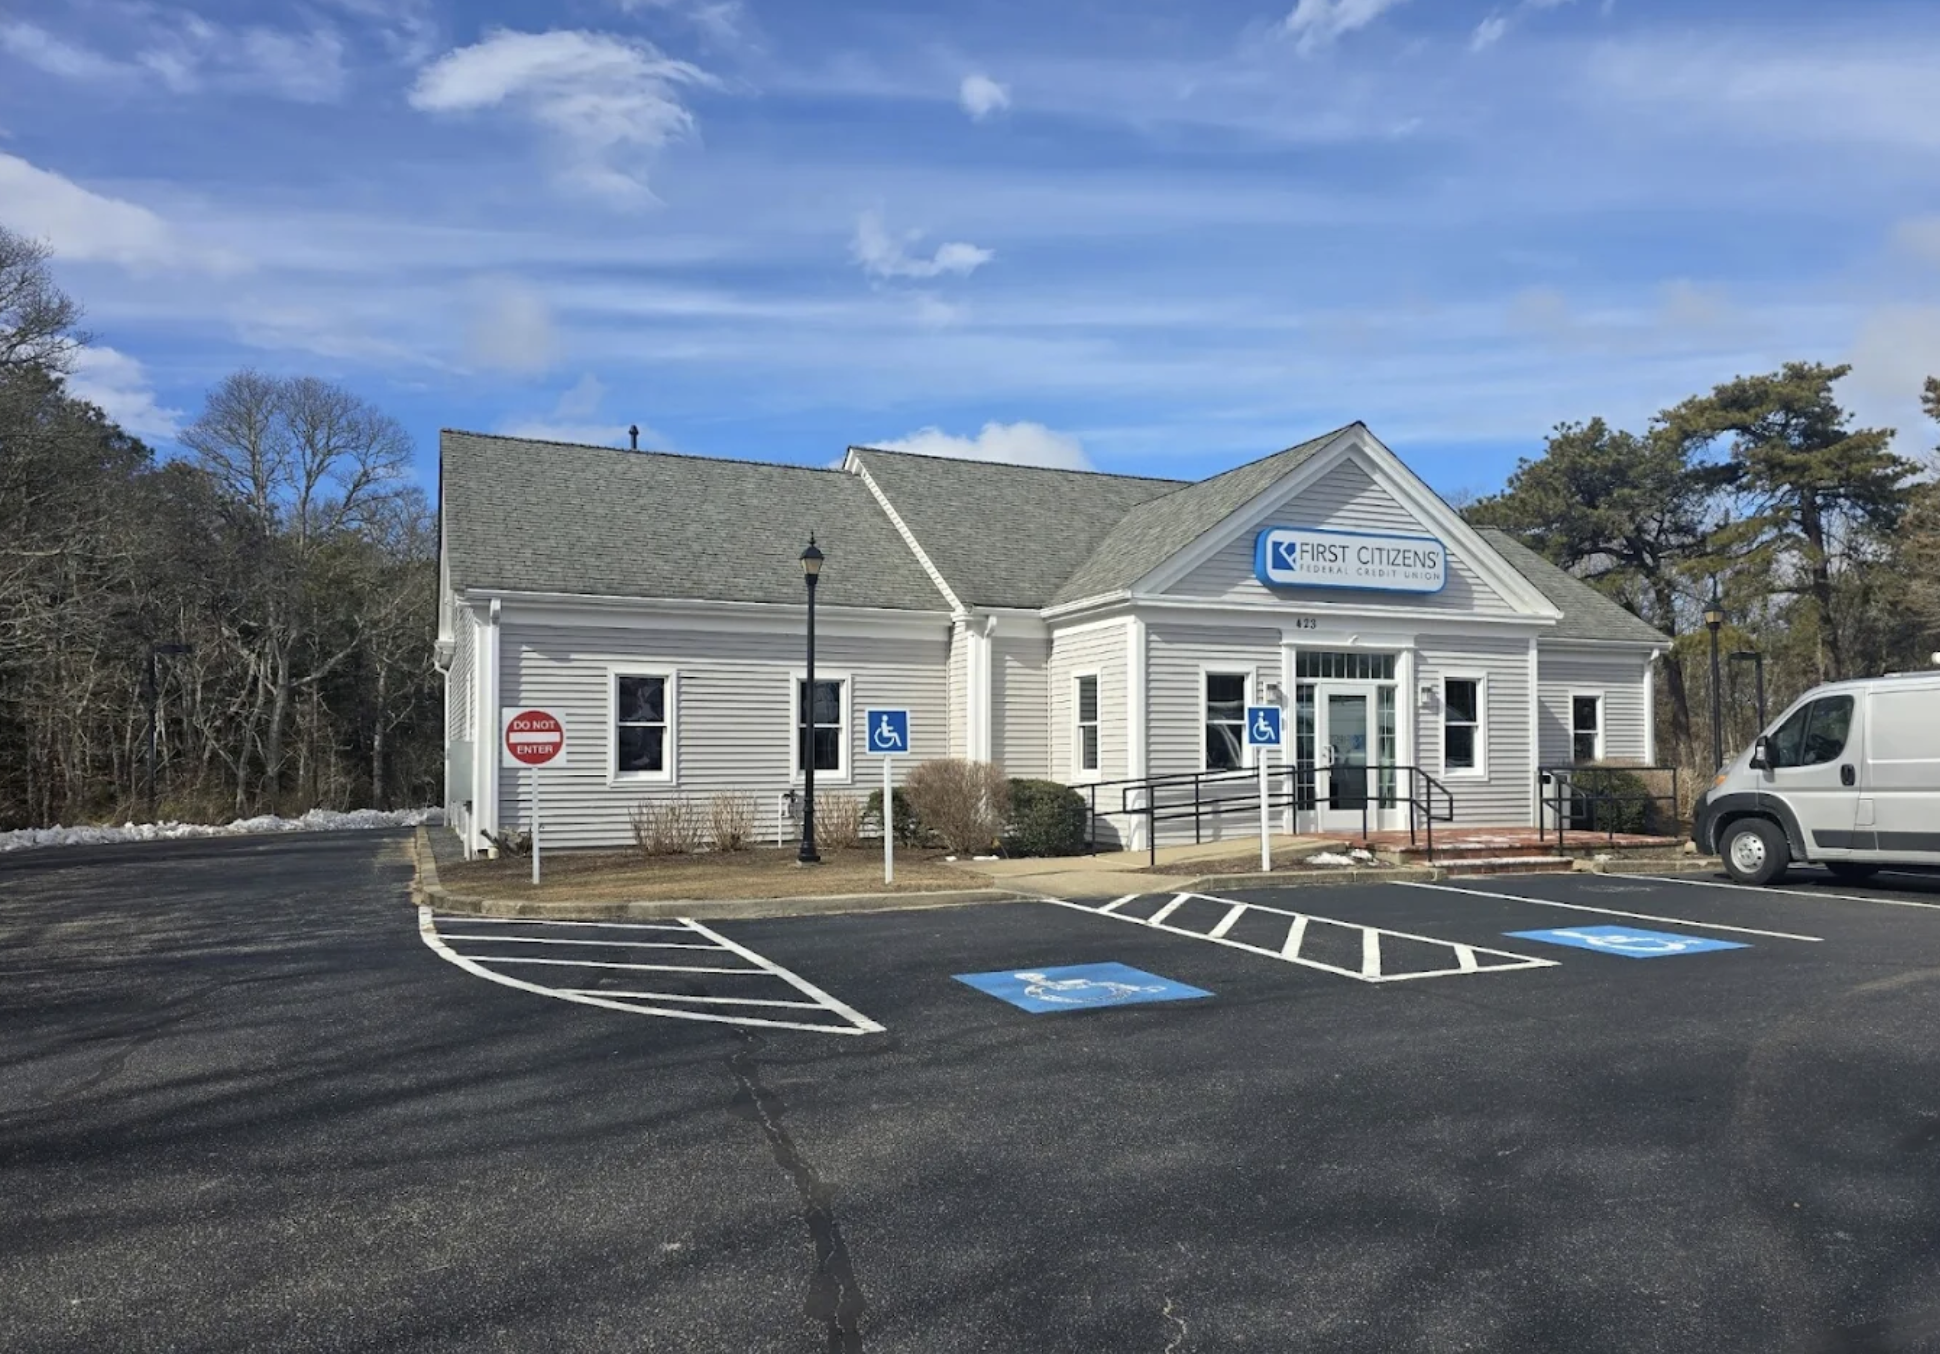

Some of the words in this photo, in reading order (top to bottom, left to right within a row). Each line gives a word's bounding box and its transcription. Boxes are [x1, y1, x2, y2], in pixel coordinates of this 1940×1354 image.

[1300, 542, 1350, 563] FIRST
[1357, 546, 1439, 569] CITIZENS'
[1300, 563, 1348, 575] FEDERAL
[1356, 567, 1397, 578] CREDIT
[1404, 571, 1440, 580] UNION
[1296, 618, 1316, 630] 423
[513, 720, 531, 730] DO
[533, 720, 556, 730] NOT
[517, 745, 553, 755] ENTER
